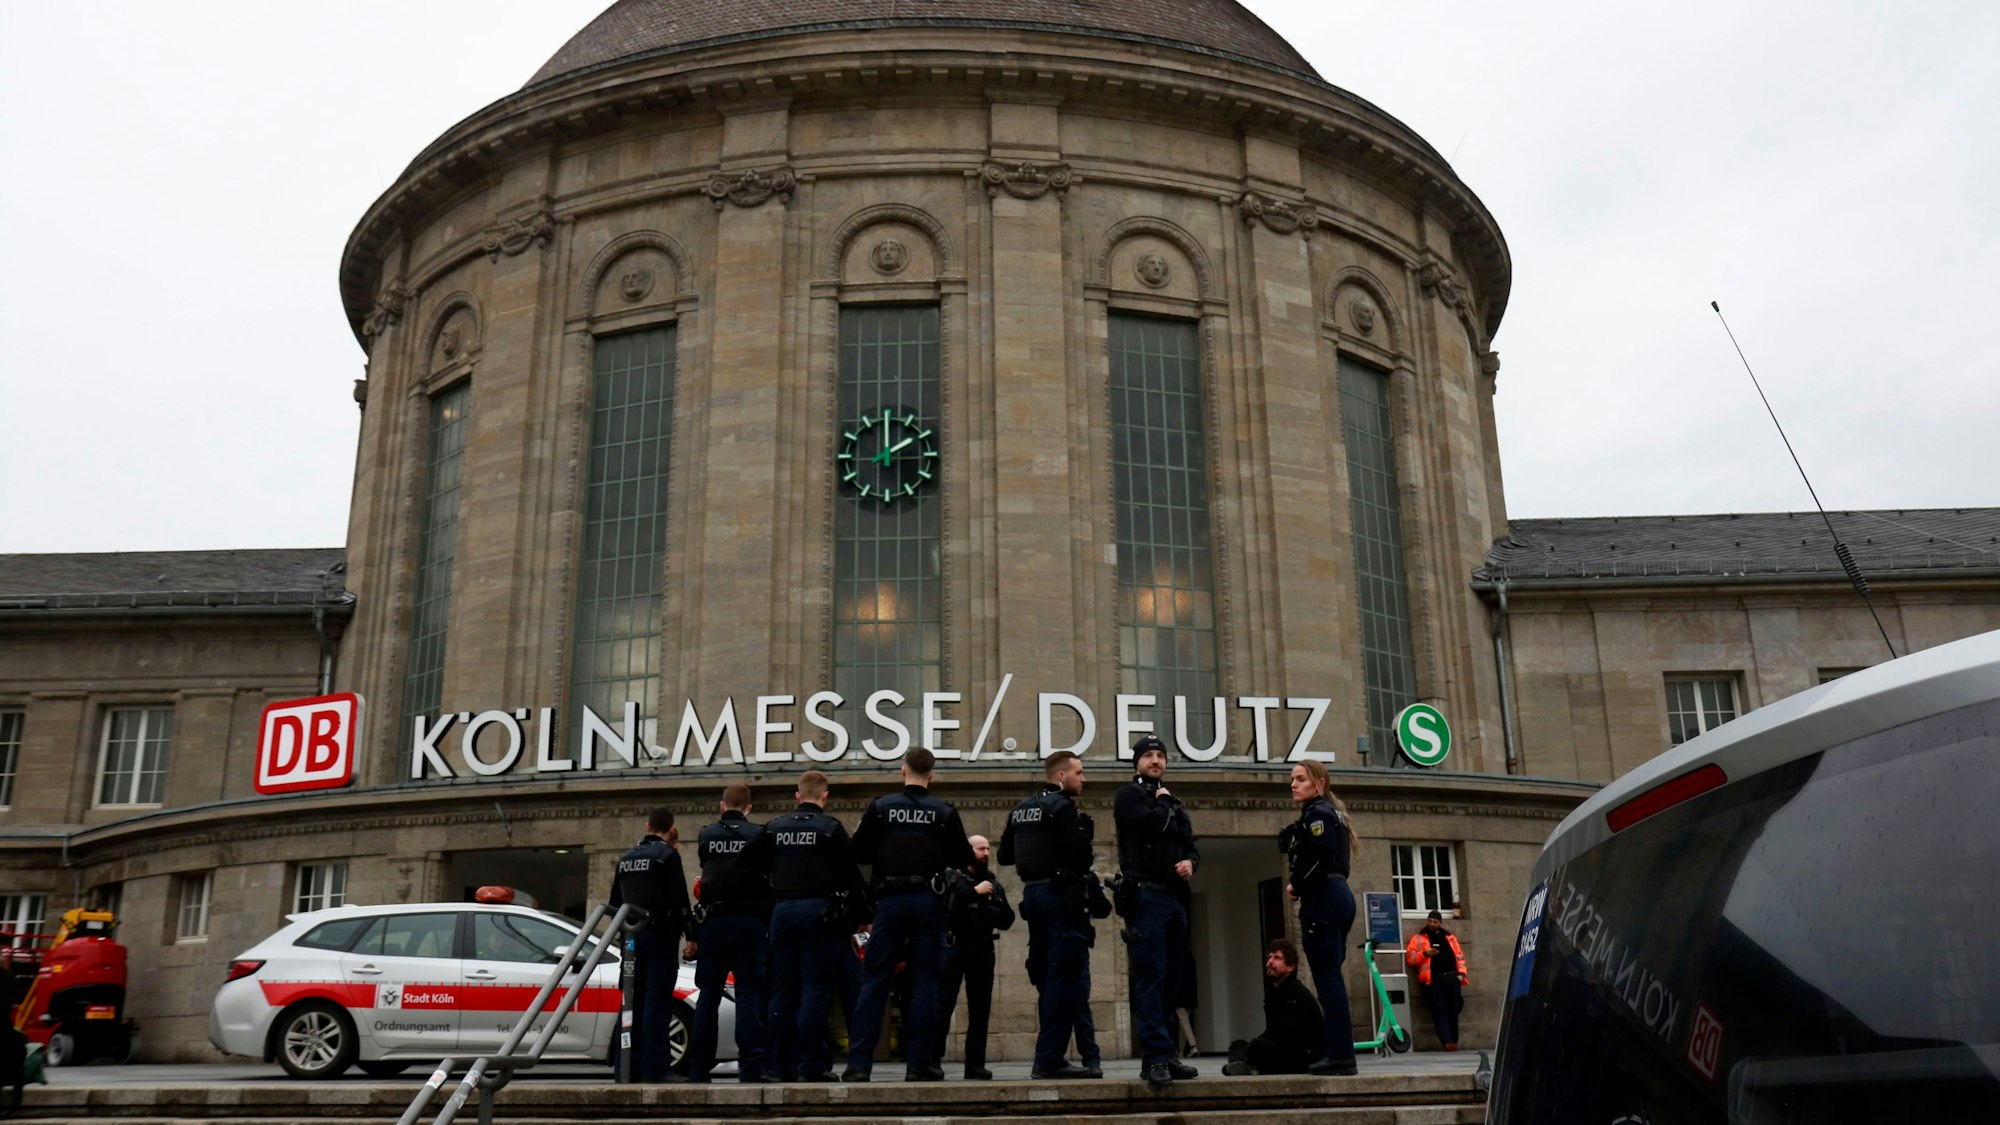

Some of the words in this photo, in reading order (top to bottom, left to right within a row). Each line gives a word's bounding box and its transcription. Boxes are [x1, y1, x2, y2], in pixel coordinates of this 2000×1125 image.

[411, 701, 638, 778] KÖLN
[1409, 710, 1441, 759] S
[268, 711, 341, 777] DB
[888, 808, 936, 825] POLIZEI
[1011, 807, 1043, 824] POLIZEI
[775, 831, 817, 846] POLIZEI
[708, 840, 746, 853] POLIZE
[619, 858, 650, 873] POLIZEI
[403, 992, 430, 1004] Stadt
[431, 993, 455, 1004] Köln
[374, 1020, 451, 1033] Ordnungsamt
[496, 1024, 512, 1033] Tel.
